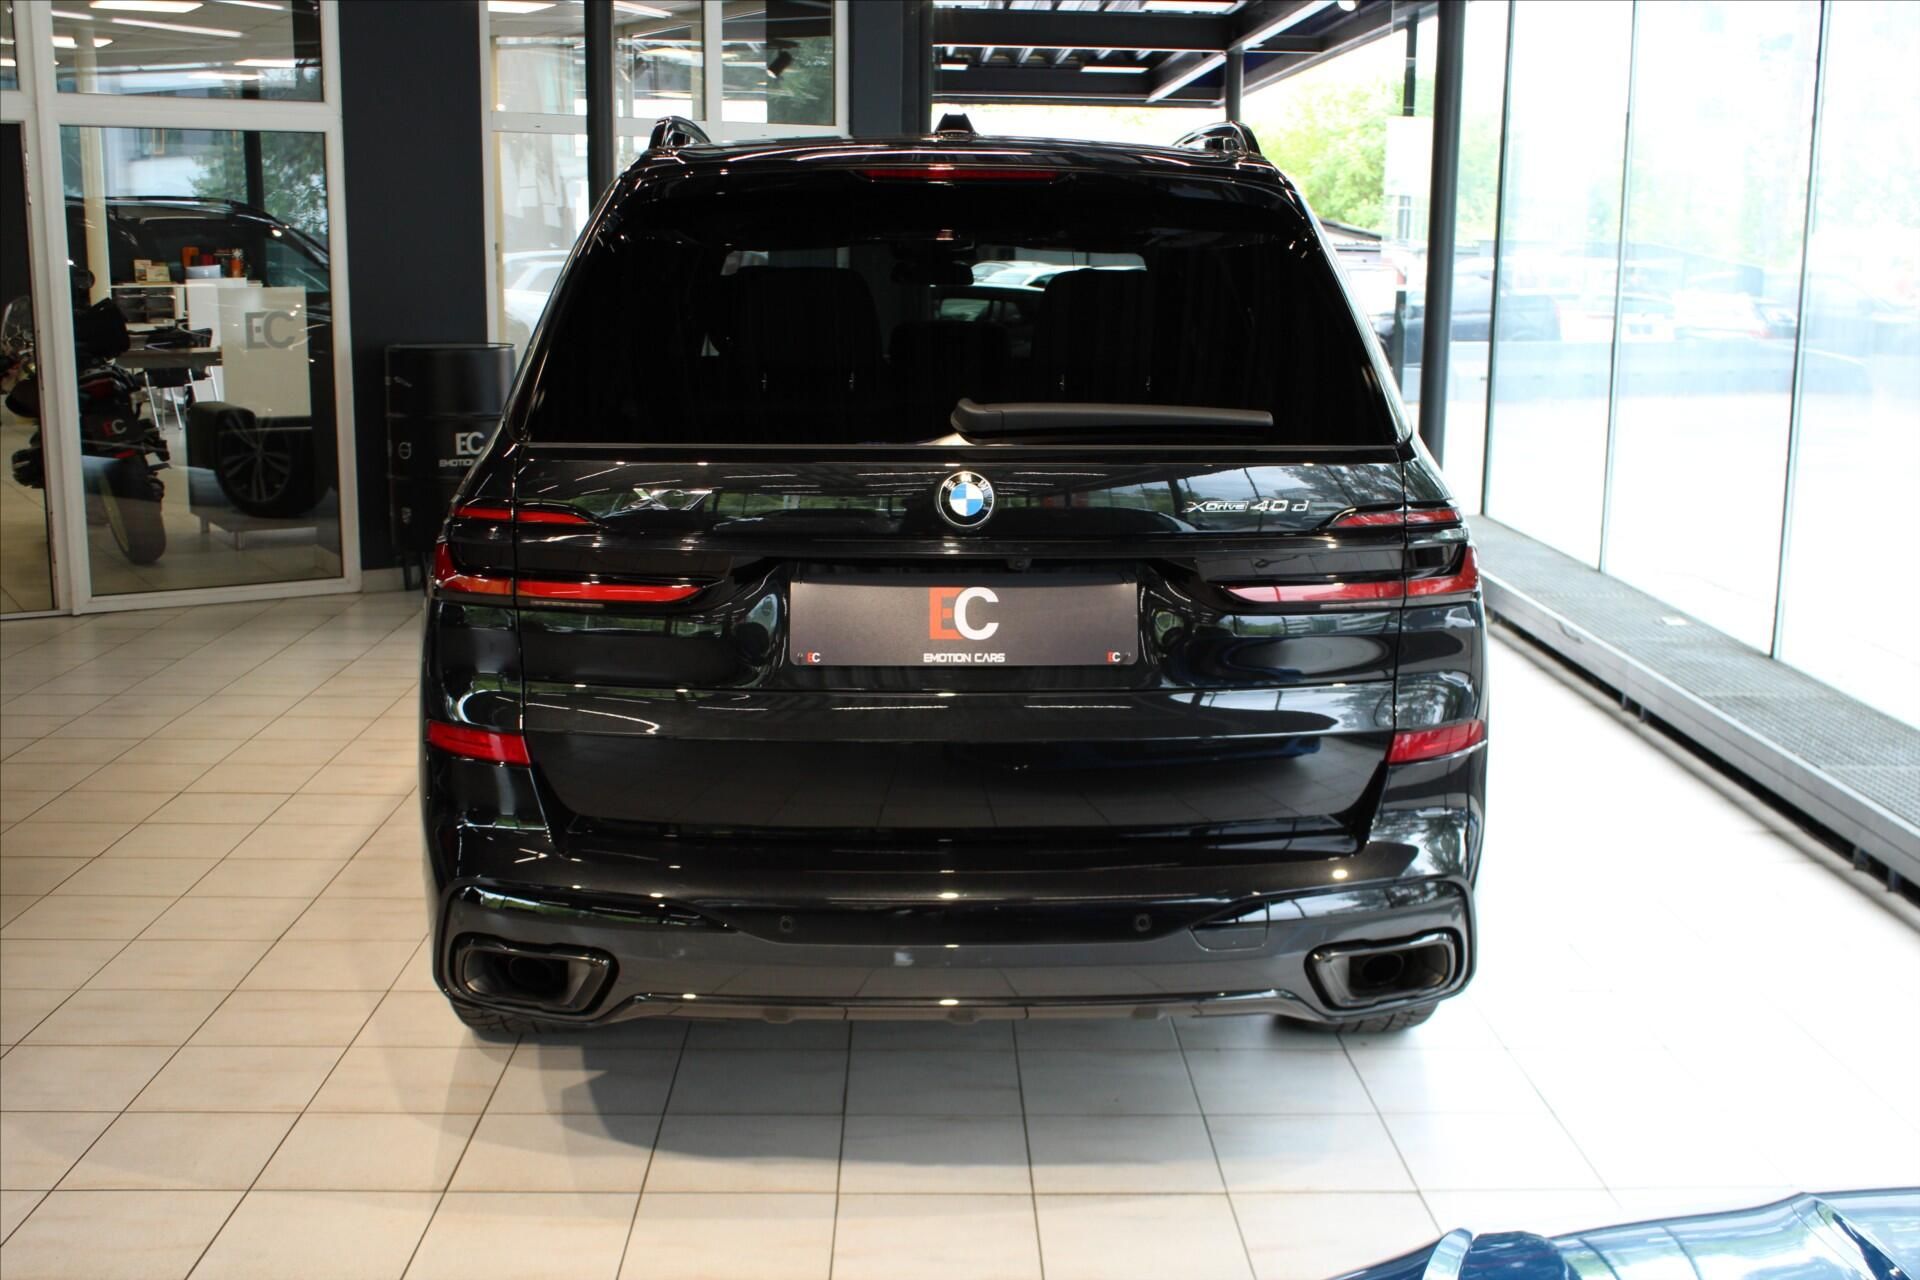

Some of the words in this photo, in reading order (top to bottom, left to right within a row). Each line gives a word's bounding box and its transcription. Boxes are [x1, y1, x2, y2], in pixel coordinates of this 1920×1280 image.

[245, 311, 296, 350] EC
[455, 431, 485, 455] EC
[928, 586, 1000, 641] EC
[806, 651, 821, 663] EC
[923, 652, 972, 663] EMOTION
[974, 652, 1006, 663] CARS
[1107, 650, 1121, 663] EC
